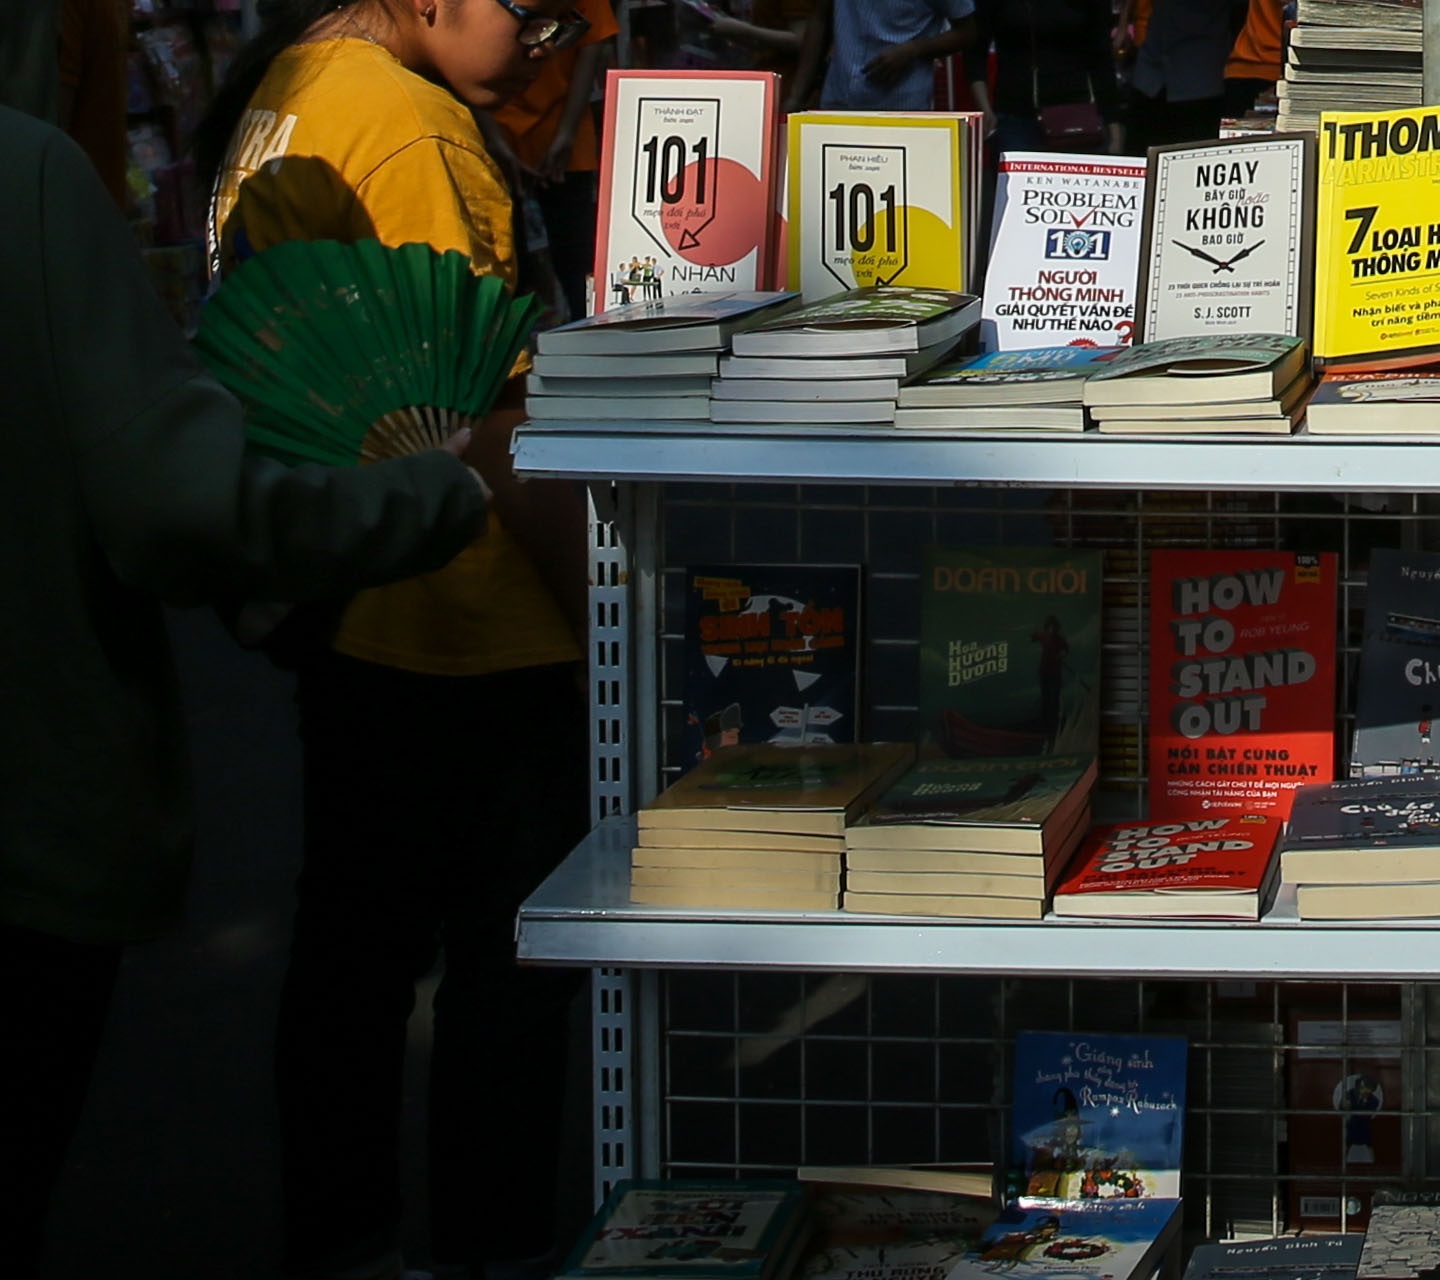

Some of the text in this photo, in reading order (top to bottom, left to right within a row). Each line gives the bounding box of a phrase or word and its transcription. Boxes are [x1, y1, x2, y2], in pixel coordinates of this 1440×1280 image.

[643, 135, 708, 205] 101
[1010, 162, 1091, 174] INTERNATIONAL
[1195, 160, 1260, 188] NGAY
[1026, 175, 1140, 190] KEN WATANABE
[1021, 189, 1138, 210] PROBLEM
[829, 182, 897, 253] 101
[1024, 206, 1134, 228] SOLVING
[1185, 203, 1265, 231] KHÔNG
[1202, 233, 1223, 246] BAO
[1344, 206, 1380, 255] 7
[1371, 224, 1422, 252] LOẠI
[672, 262, 736, 283] NHÂN
[1351, 251, 1421, 279] THÔNG
[1037, 268, 1098, 285] NGƯỜI
[1008, 285, 1125, 303] THÔNG MINH
[1364, 289, 1393, 301] Seven
[1395, 285, 1421, 299] Kinds
[1422, 284, 1433, 297] of
[1216, 305, 1252, 319] SCOTT
[1173, 567, 1286, 616] HOW
[1172, 616, 1236, 657] TO
[1172, 648, 1317, 698] STAND
[1172, 695, 1268, 739] OUT
[1112, 818, 1231, 841] HOW
[1101, 839, 1255, 862] STAND
[1108, 836, 1171, 851] TO
[1095, 853, 1198, 873] OUT
